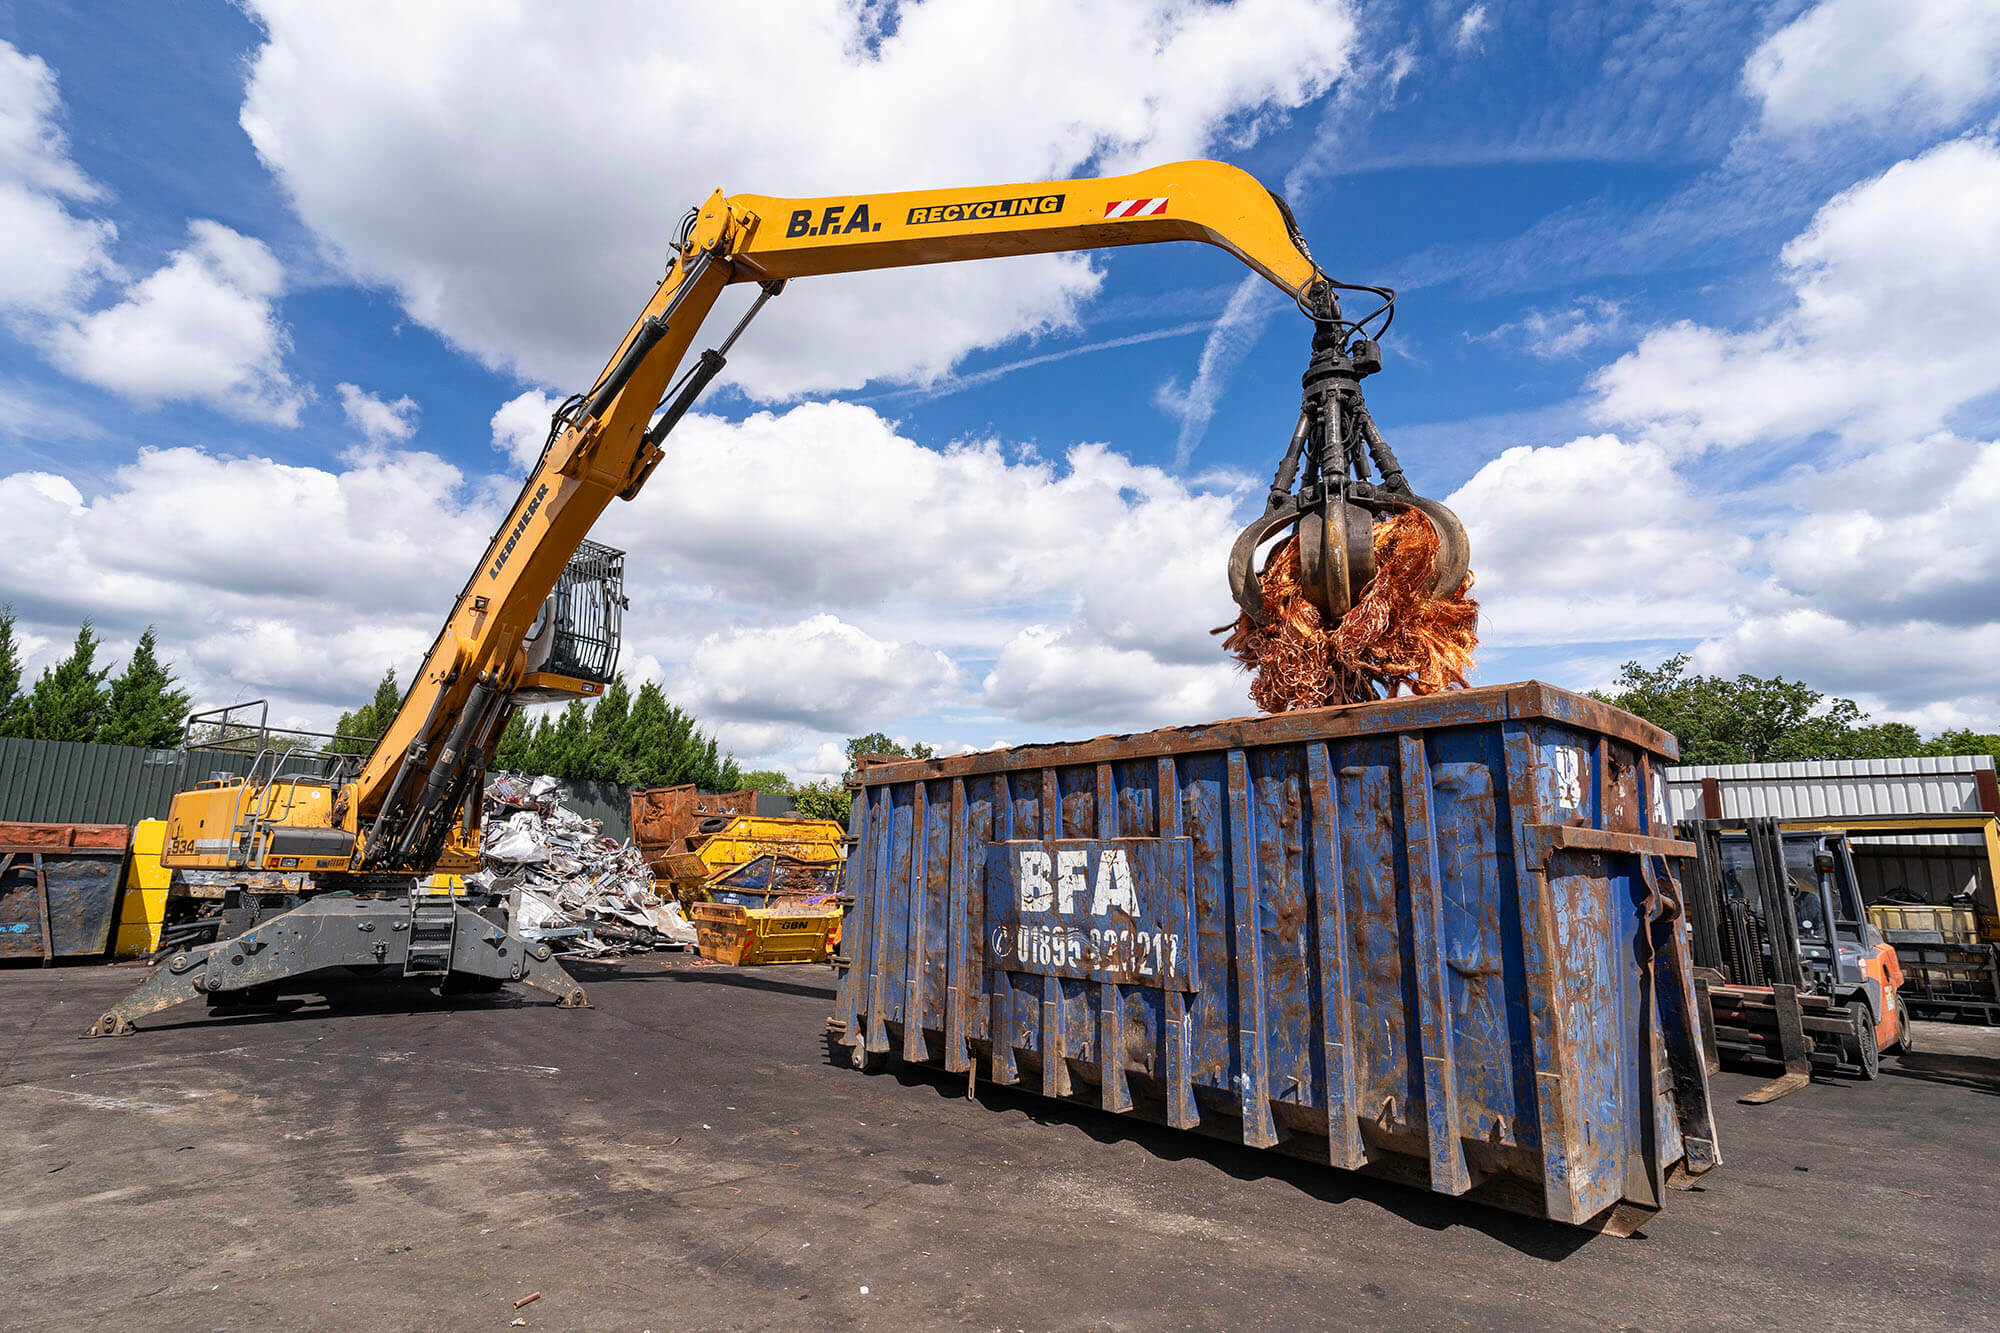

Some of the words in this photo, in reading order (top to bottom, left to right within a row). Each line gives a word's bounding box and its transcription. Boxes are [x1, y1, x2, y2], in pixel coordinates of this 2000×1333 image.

[786, 203, 882, 239] B.F.A.
[911, 196, 1059, 224] RECYCLING
[489, 483, 549, 580] LIEBHERR
[172, 839, 195, 854] 934
[1020, 849, 1141, 917] BFA
[781, 920, 809, 930] GBN
[1017, 924, 1081, 968] 01895
